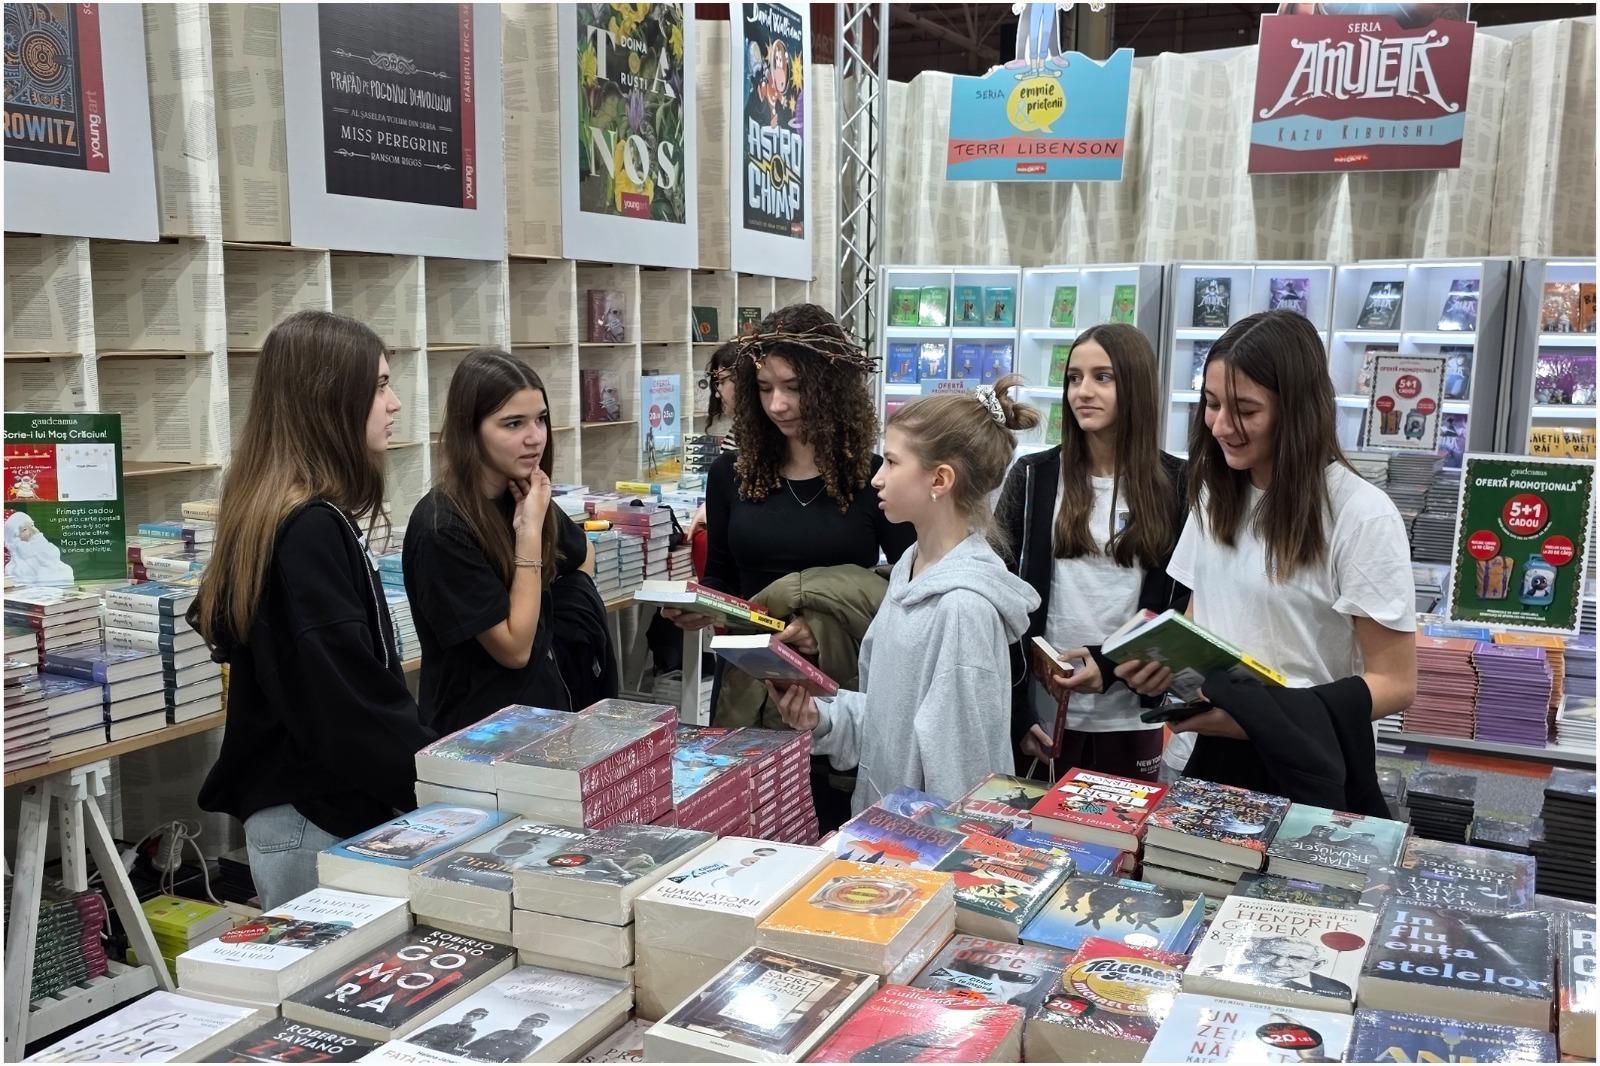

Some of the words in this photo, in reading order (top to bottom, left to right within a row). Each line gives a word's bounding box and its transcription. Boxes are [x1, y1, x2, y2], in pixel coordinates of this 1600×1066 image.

[1347, 22, 1382, 33] SERIA
[621, 35, 648, 54] DOINA
[1259, 29, 1459, 119] AMULETA
[330, 71, 362, 95] PRĂPĂD
[362, 80, 370, 95] PE
[370, 80, 408, 105] POGONUL
[975, 89, 1005, 100] SERIA
[1020, 83, 1055, 99] emmie
[4, 112, 77, 147] ROWITZ
[408, 118, 419, 127] DIN
[419, 121, 437, 131] SERIA
[341, 125, 373, 143] MISS
[377, 131, 449, 155] PEREGRINE
[1278, 127, 1323, 143] KAZU
[1341, 124, 1434, 141] KIBUISHI
[748, 117, 801, 169] ASTRO
[954, 143, 1005, 156] TERRI
[1017, 142, 1119, 155] LIBENSON
[370, 152, 401, 164] RANSOM
[401, 156, 423, 168] RIGGS
[588, 126, 675, 190] NOS
[748, 162, 800, 222] CHIMP
[937, 381, 965, 389] OFERTĂ
[1398, 378, 1417, 388] 5+1
[31, 416, 79, 428] gaudeamus
[35, 430, 46, 439] lui
[48, 430, 67, 440] Moș
[69, 429, 107, 439] Crăciun!
[1510, 468, 1548, 476] gaudeamus
[1475, 478, 1508, 488] OFERTĂ
[1510, 501, 1541, 518] 5+1
[1509, 518, 1539, 528] CADOU
[60, 538, 77, 547] Moș
[1053, 812, 1083, 822] Keyes
[1086, 818, 1121, 829] Daniel
[657, 885, 761, 907] LUMINATORII
[662, 893, 702, 903] ELEANOR
[705, 899, 743, 909] CATTON
[1396, 899, 1442, 909] EMMA
[1235, 902, 1285, 913] Jurnalul
[1288, 908, 1322, 919] secret
[1341, 916, 1358, 924] lui
[1237, 910, 1350, 932] HENDRIK
[1394, 910, 1433, 927] In
[429, 930, 495, 950] ROBERTO
[1388, 924, 1448, 943] flu
[419, 936, 484, 957] SAVIANO
[1383, 941, 1479, 961] ența
[1375, 959, 1548, 990] stelelor
[1050, 999, 1072, 1009] 20
[272, 1032, 344, 1055] SAVIANO
[286, 1023, 357, 1047] ROBERTO
[1268, 1033, 1297, 1043] 20
